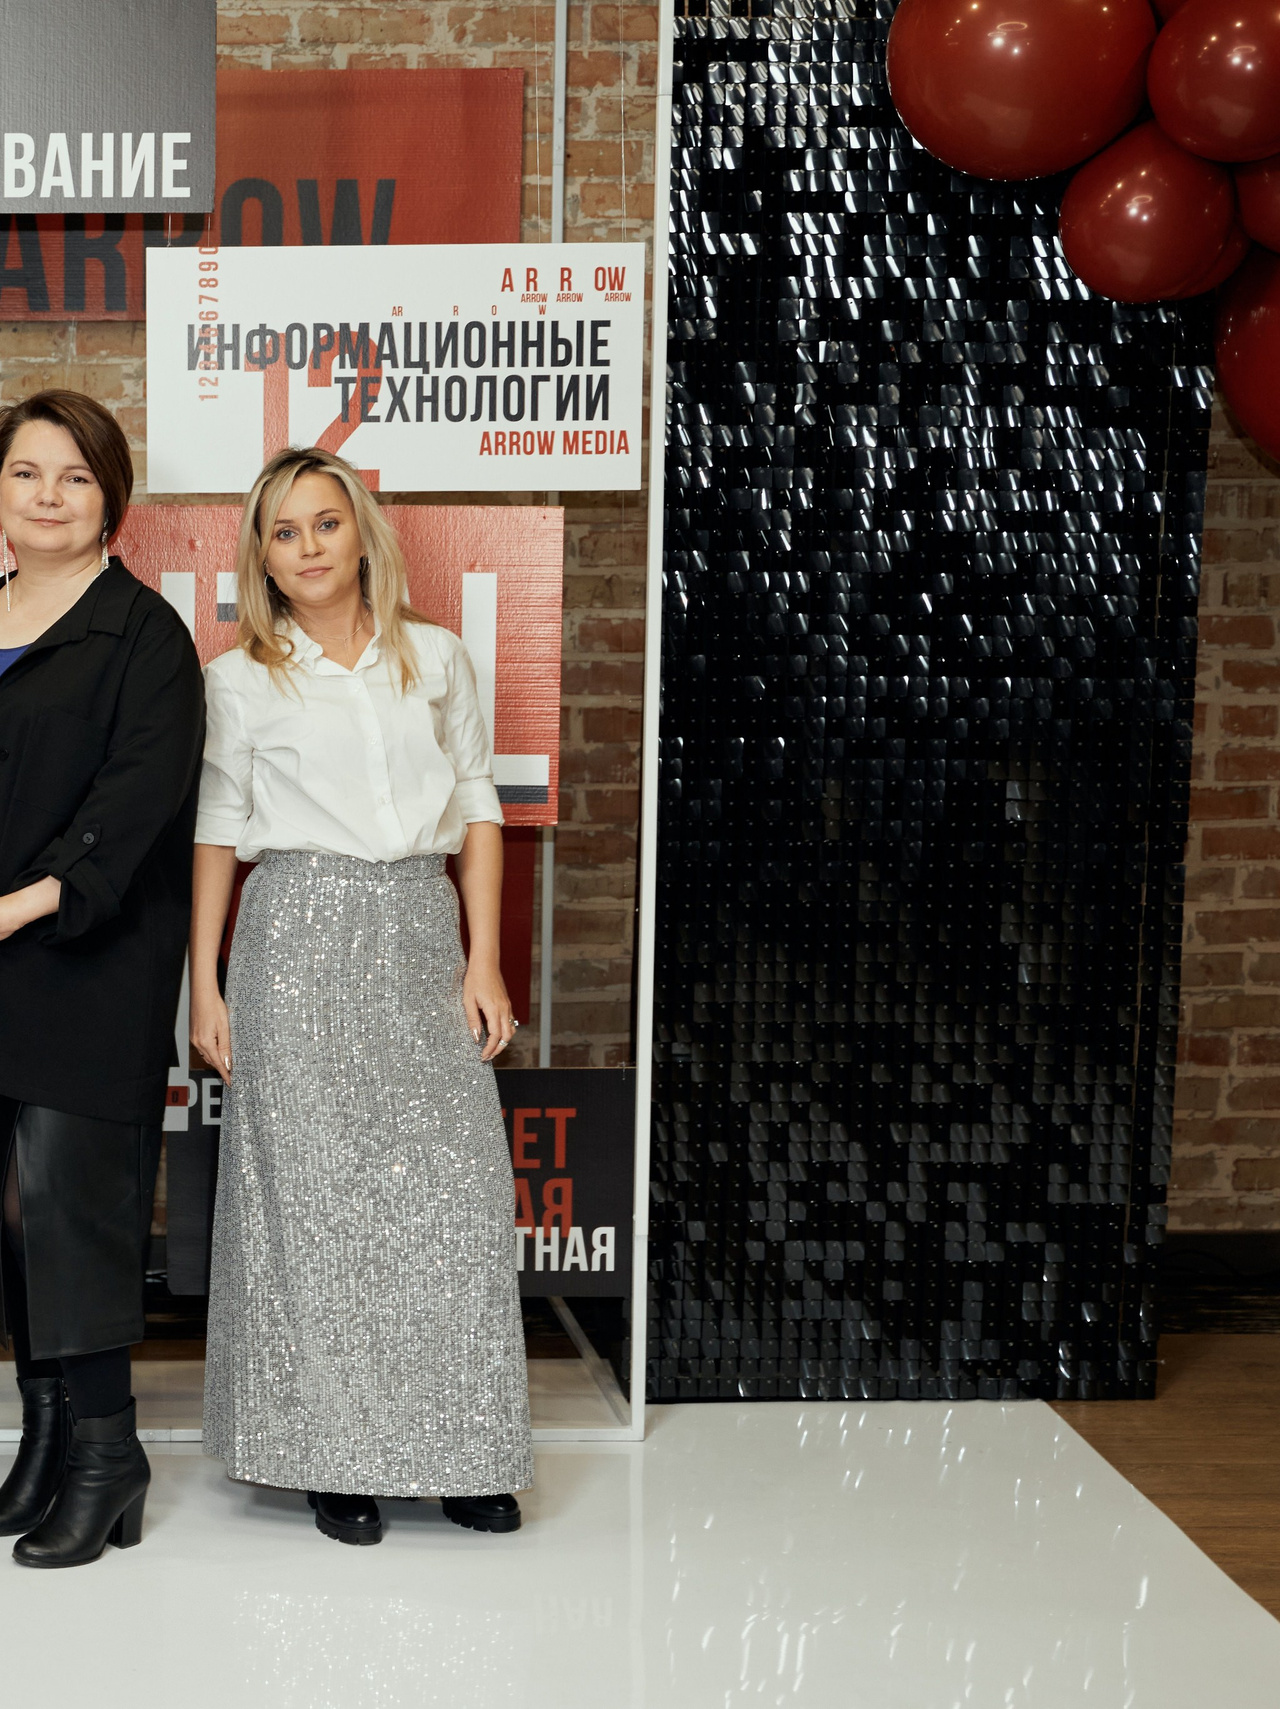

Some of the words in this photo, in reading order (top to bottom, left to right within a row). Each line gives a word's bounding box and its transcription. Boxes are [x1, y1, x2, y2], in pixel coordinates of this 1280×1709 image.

[521, 293, 548, 303] ARROW
[556, 293, 583, 303] ARROW
[604, 292, 632, 302] ARROW
[187, 319, 611, 374] ИНФОРМАЦИОННЫЕ
[334, 374, 610, 424] ТЕХНОЛОГИИ
[479, 431, 554, 456] ARROW
[563, 430, 630, 455] MEDIA
